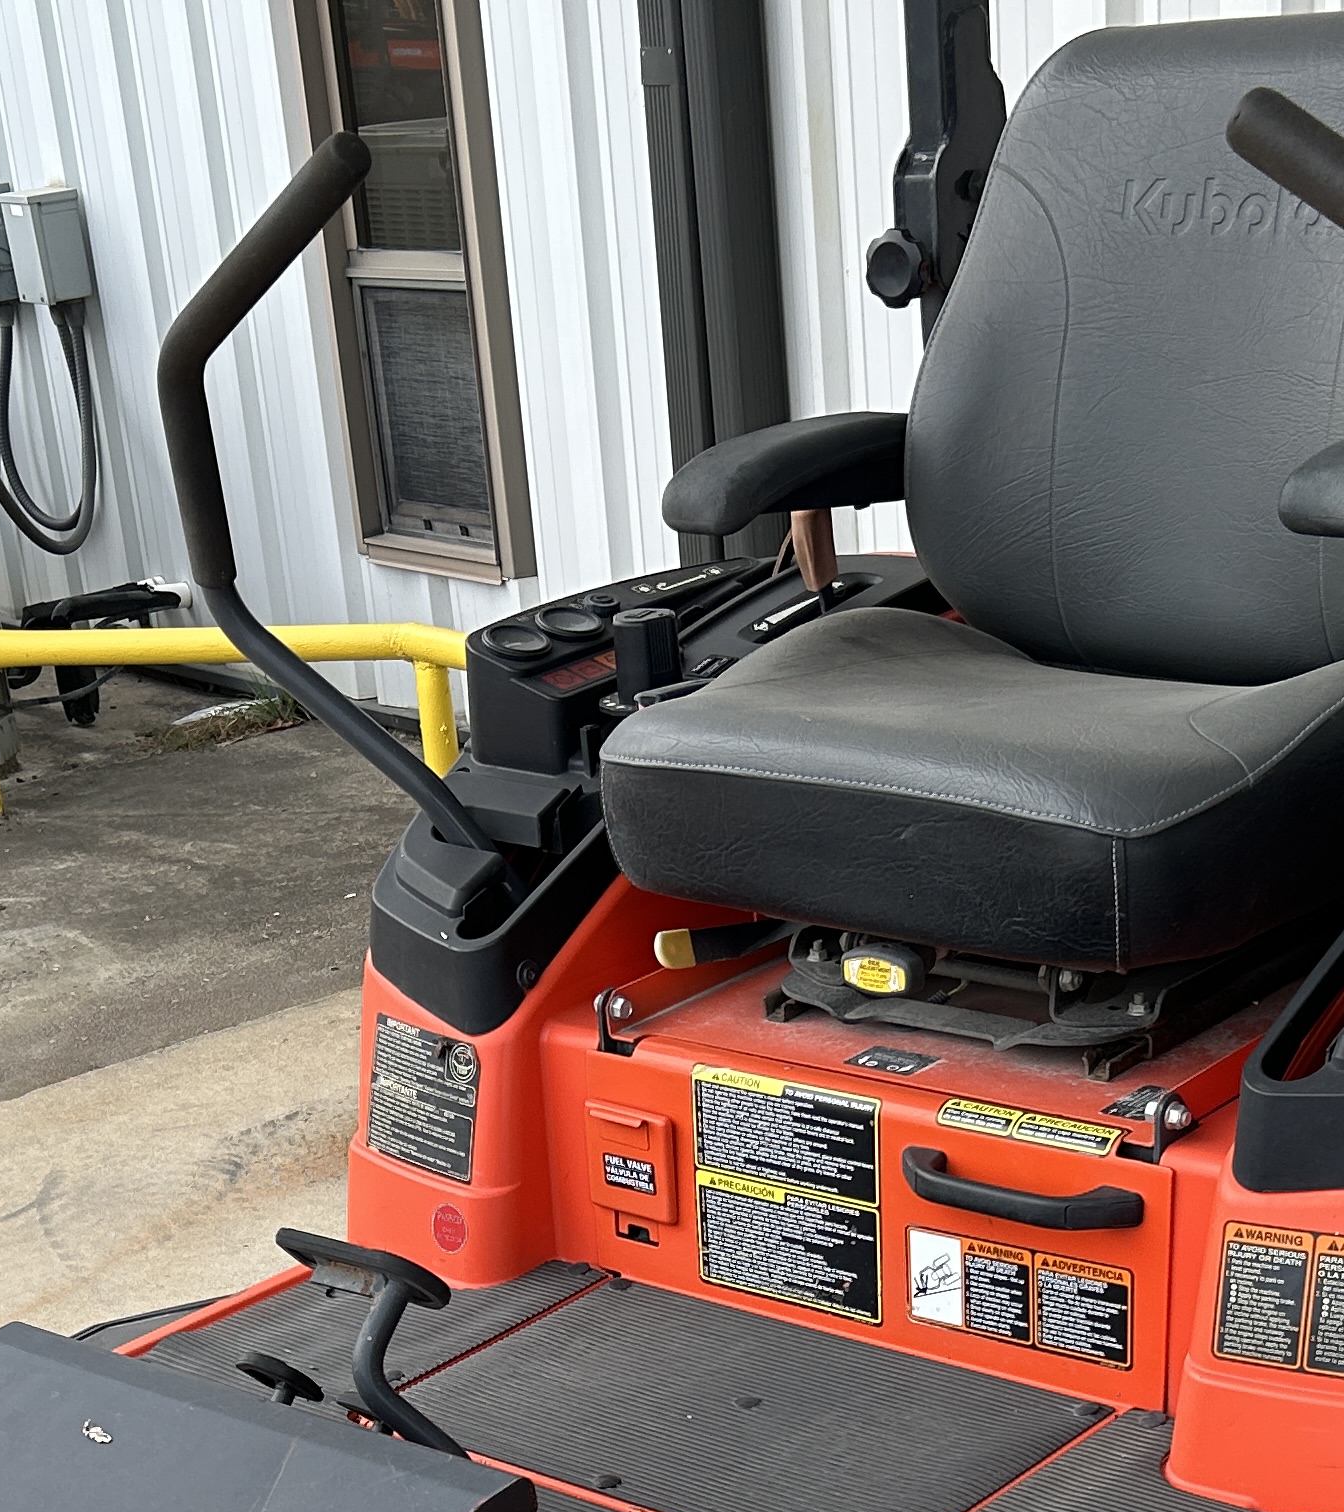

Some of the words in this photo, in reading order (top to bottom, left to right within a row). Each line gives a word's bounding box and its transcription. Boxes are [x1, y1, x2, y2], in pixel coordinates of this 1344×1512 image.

[721, 1072, 760, 1089] CAUTION
[963, 1103, 1016, 1117] CAUTION
[605, 1154, 625, 1168] FUEL
[626, 1159, 652, 1174] VALVE
[1244, 1228, 1303, 1246] WARNING
[977, 1243, 1024, 1262] WARNING
[1227, 1242, 1239, 1251] TO
[1240, 1243, 1266, 1254] AVOID
[1267, 1247, 1306, 1260] SERIOUS
[1227, 1250, 1257, 1260] INJURY
[1258, 1254, 1271, 1262] OR
[1272, 1256, 1302, 1266] DEATH
[1319, 1254, 1343, 1265] PARA
[1051, 1258, 1123, 1282] ADVERTENCIA
[1327, 1270, 1339, 1279] LA
